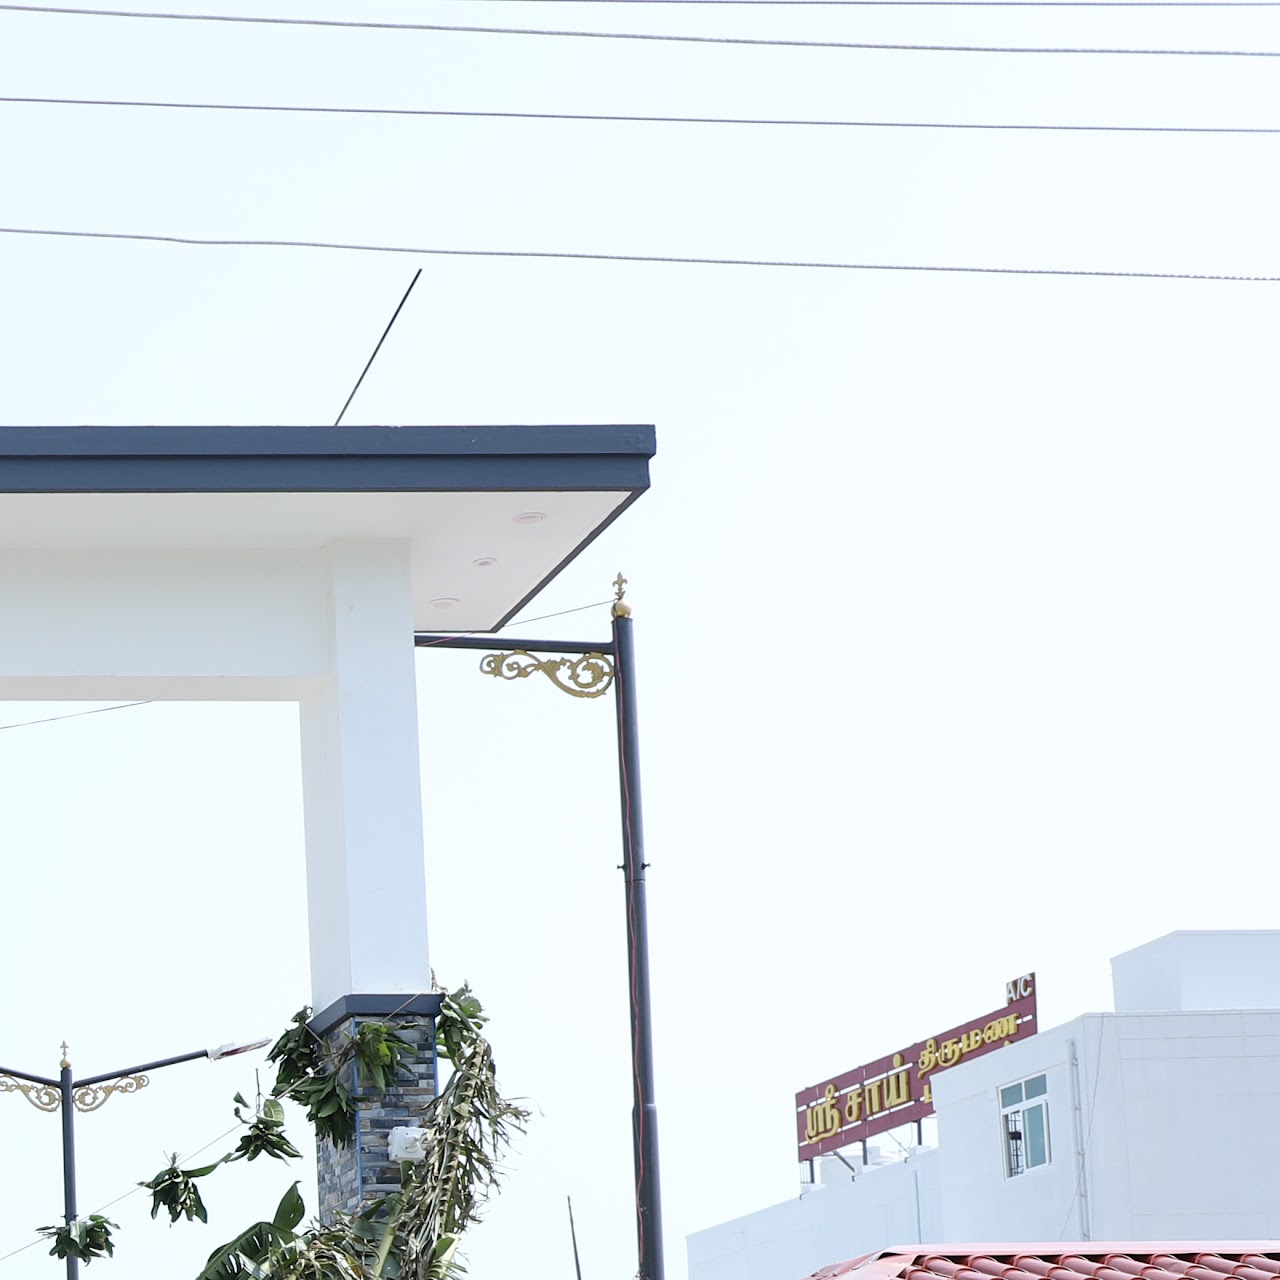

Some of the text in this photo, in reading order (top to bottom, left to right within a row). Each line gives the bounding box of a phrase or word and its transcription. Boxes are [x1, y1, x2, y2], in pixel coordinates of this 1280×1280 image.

[1006, 974, 1034, 1003] A/C
[917, 1012, 1021, 1078] திருமண
[844, 1053, 910, 1122] சாய்
